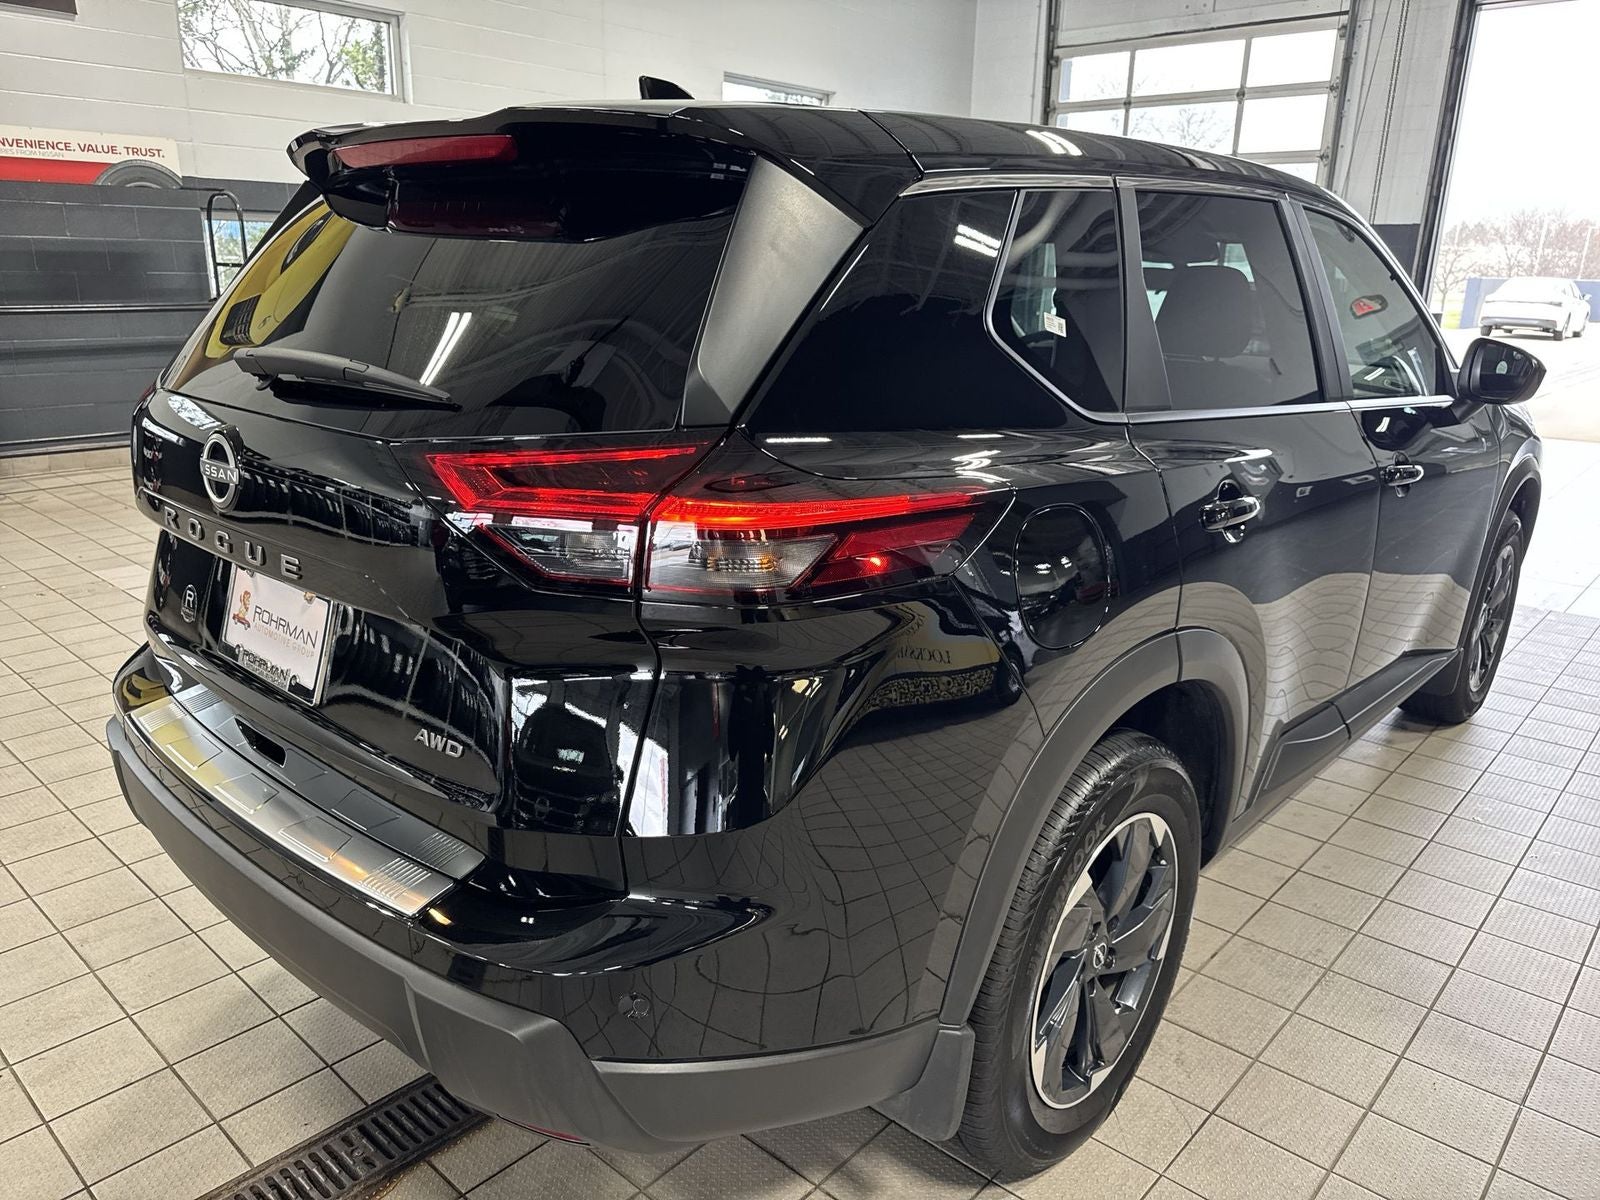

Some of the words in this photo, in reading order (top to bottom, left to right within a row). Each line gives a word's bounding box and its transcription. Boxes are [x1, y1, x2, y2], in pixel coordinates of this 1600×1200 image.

[78, 143, 122, 155] VALUE.
[124, 146, 165, 158] TRUST.
[164, 505, 302, 580] ROGUE
[185, 590, 194, 608] R
[253, 605, 318, 648] ROHRMAN
[254, 623, 291, 648] AUTOMOTIVE
[292, 642, 315, 658] GROUP
[242, 650, 288, 681] ROHRMAN
[414, 728, 463, 758] AWD
